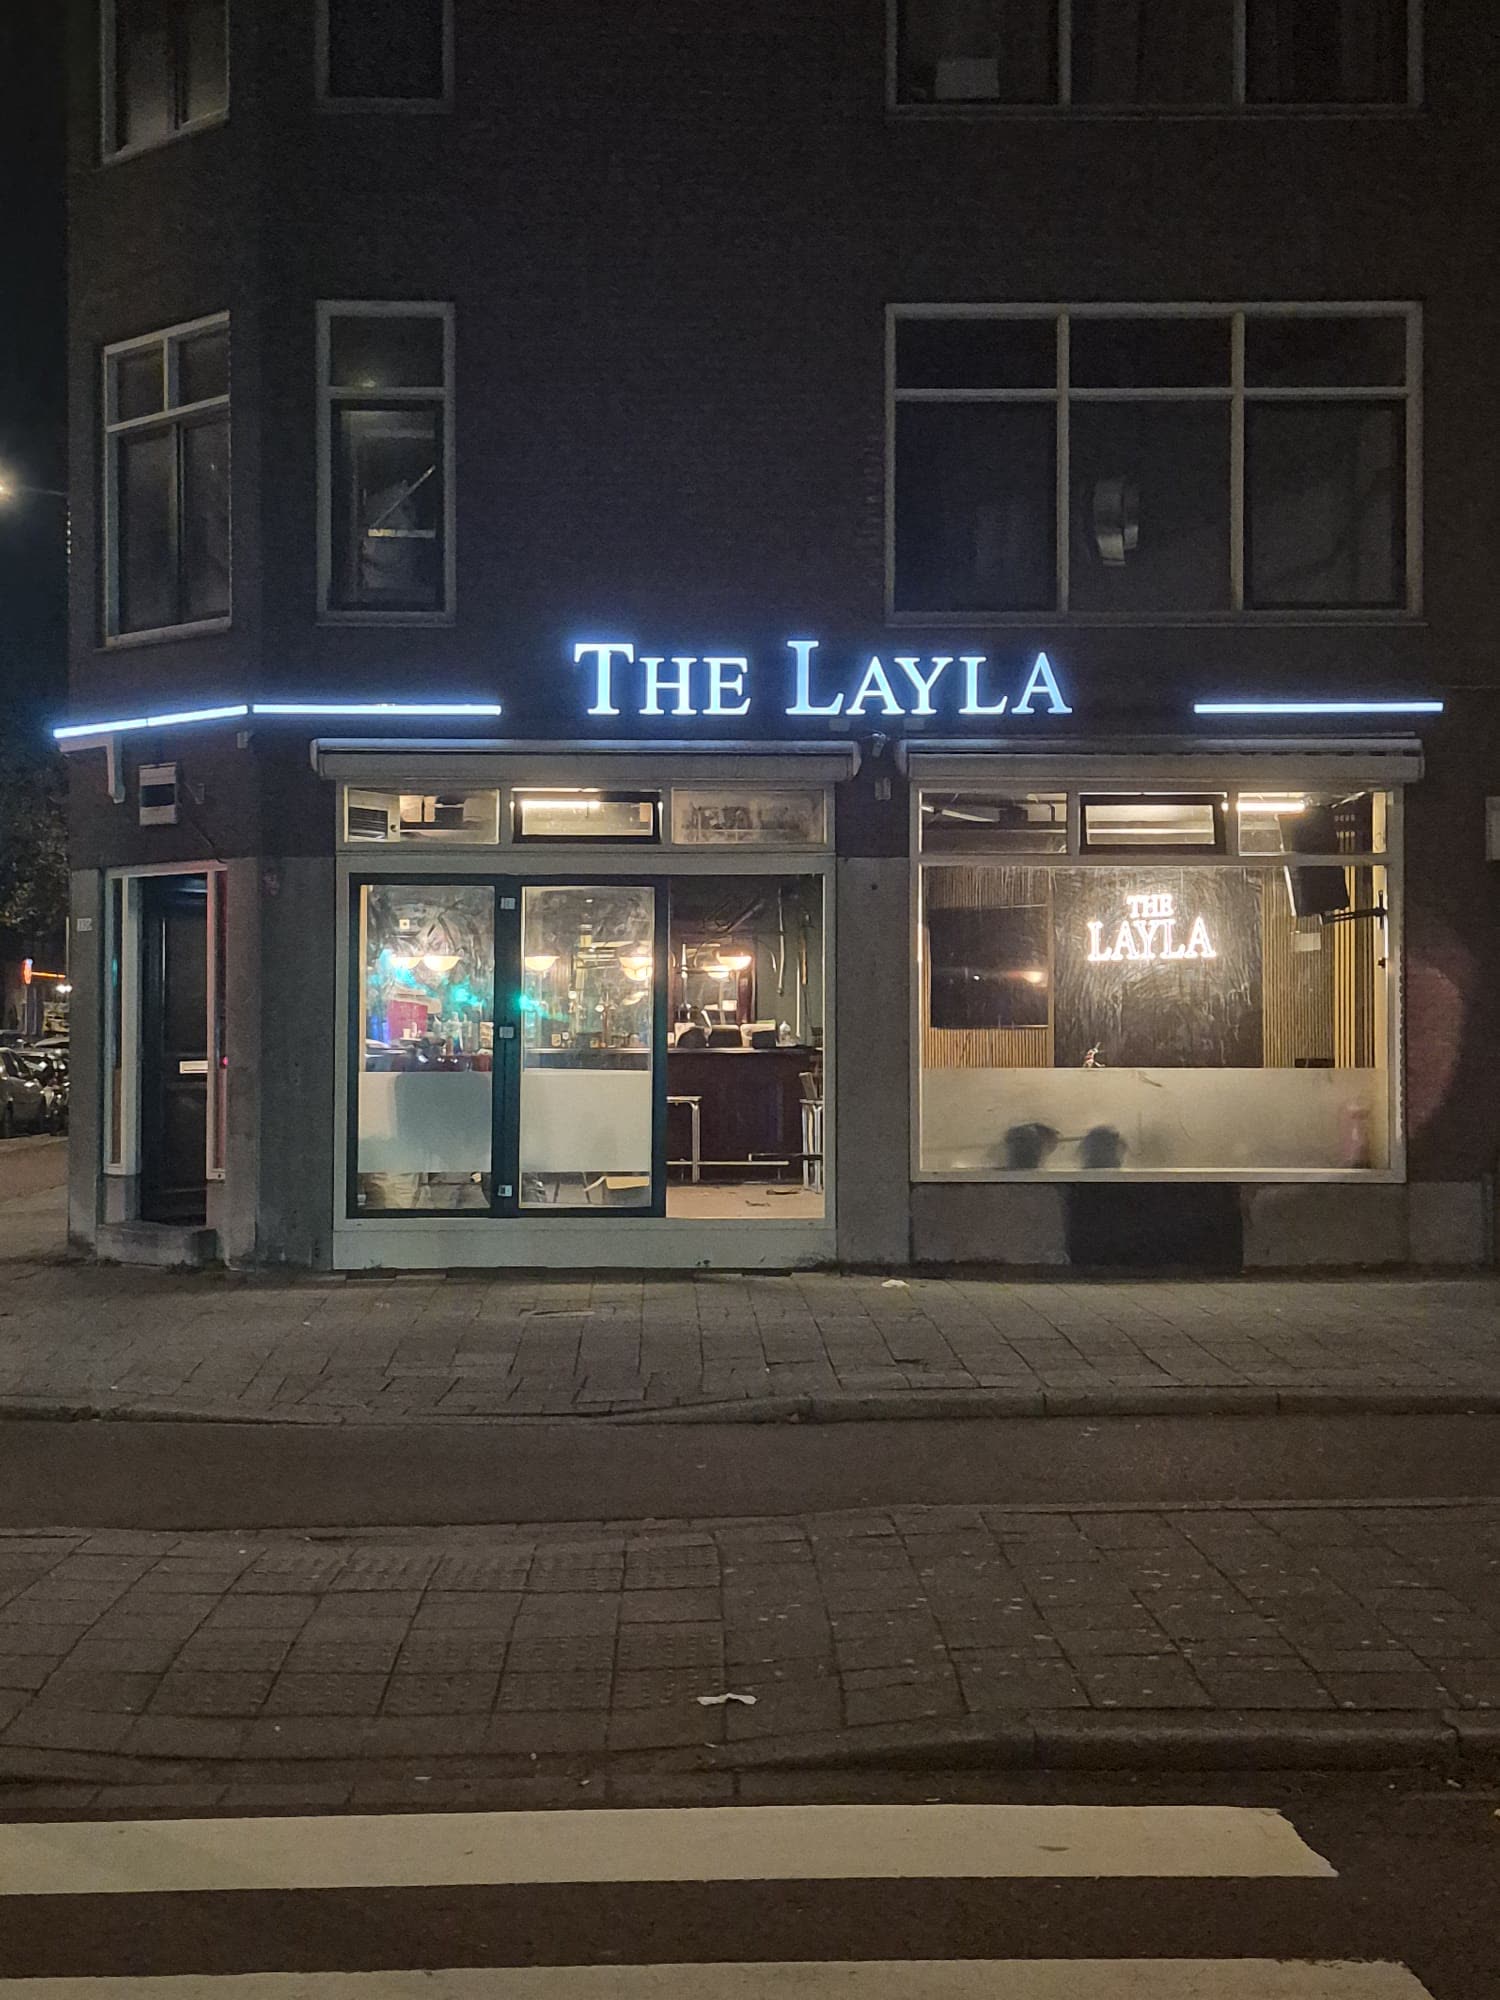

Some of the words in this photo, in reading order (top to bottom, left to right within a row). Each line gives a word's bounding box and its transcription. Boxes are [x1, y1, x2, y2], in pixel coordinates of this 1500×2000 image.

[573, 641, 751, 715] THE
[785, 640, 1073, 715] LAYLA
[1126, 893, 1174, 919] THE
[1087, 916, 1217, 962] LAYLA
